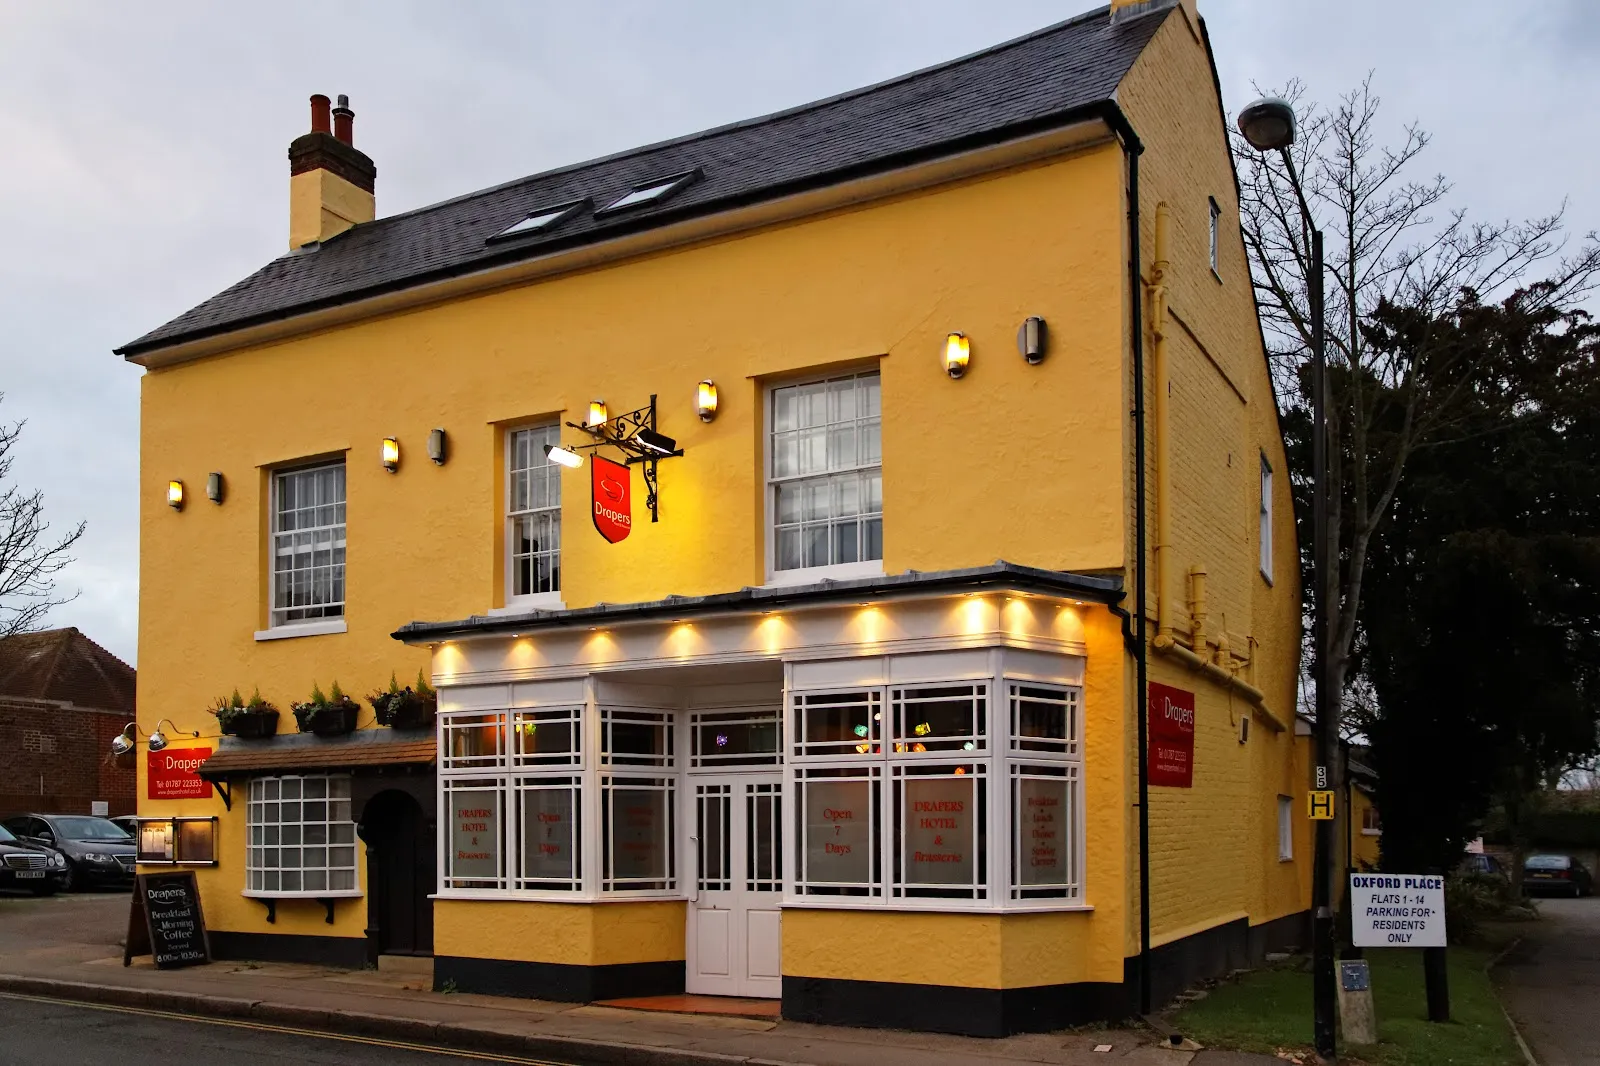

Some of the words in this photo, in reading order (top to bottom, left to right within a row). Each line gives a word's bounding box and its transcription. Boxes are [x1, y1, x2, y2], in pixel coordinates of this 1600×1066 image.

[595, 501, 631, 525] Drapers
[1164, 696, 1193, 727] Drapers
[166, 756, 206, 772] Drapers
[165, 780, 181, 788] 01787
[182, 779, 203, 788] 223353
[914, 801, 964, 812] DRAPERS
[1311, 794, 1330, 817] H
[458, 809, 492, 818] DRAPERS
[823, 808, 853, 822] Open
[462, 823, 488, 832] HOTEL
[920, 818, 957, 829] HOTEL
[834, 825, 841, 836] 7
[934, 835, 943, 845] &
[825, 842, 851, 856] Days
[458, 850, 491, 860] Brasserie
[914, 851, 962, 863] Brasserie
[1353, 877, 1401, 889] OXFORD
[1404, 878, 1441, 890] PLACE
[148, 888, 186, 900] Drapers
[1371, 894, 1400, 904] FLATS
[1402, 895, 1407, 905] 1
[1415, 895, 1424, 905] 14
[151, 908, 191, 920] Breakfast
[1366, 907, 1409, 917] PARKING
[1411, 907, 1430, 917] FOR
[161, 919, 195, 931] Morning
[1372, 920, 1425, 930] RESIDENTS
[1388, 933, 1412, 943] ONLY
